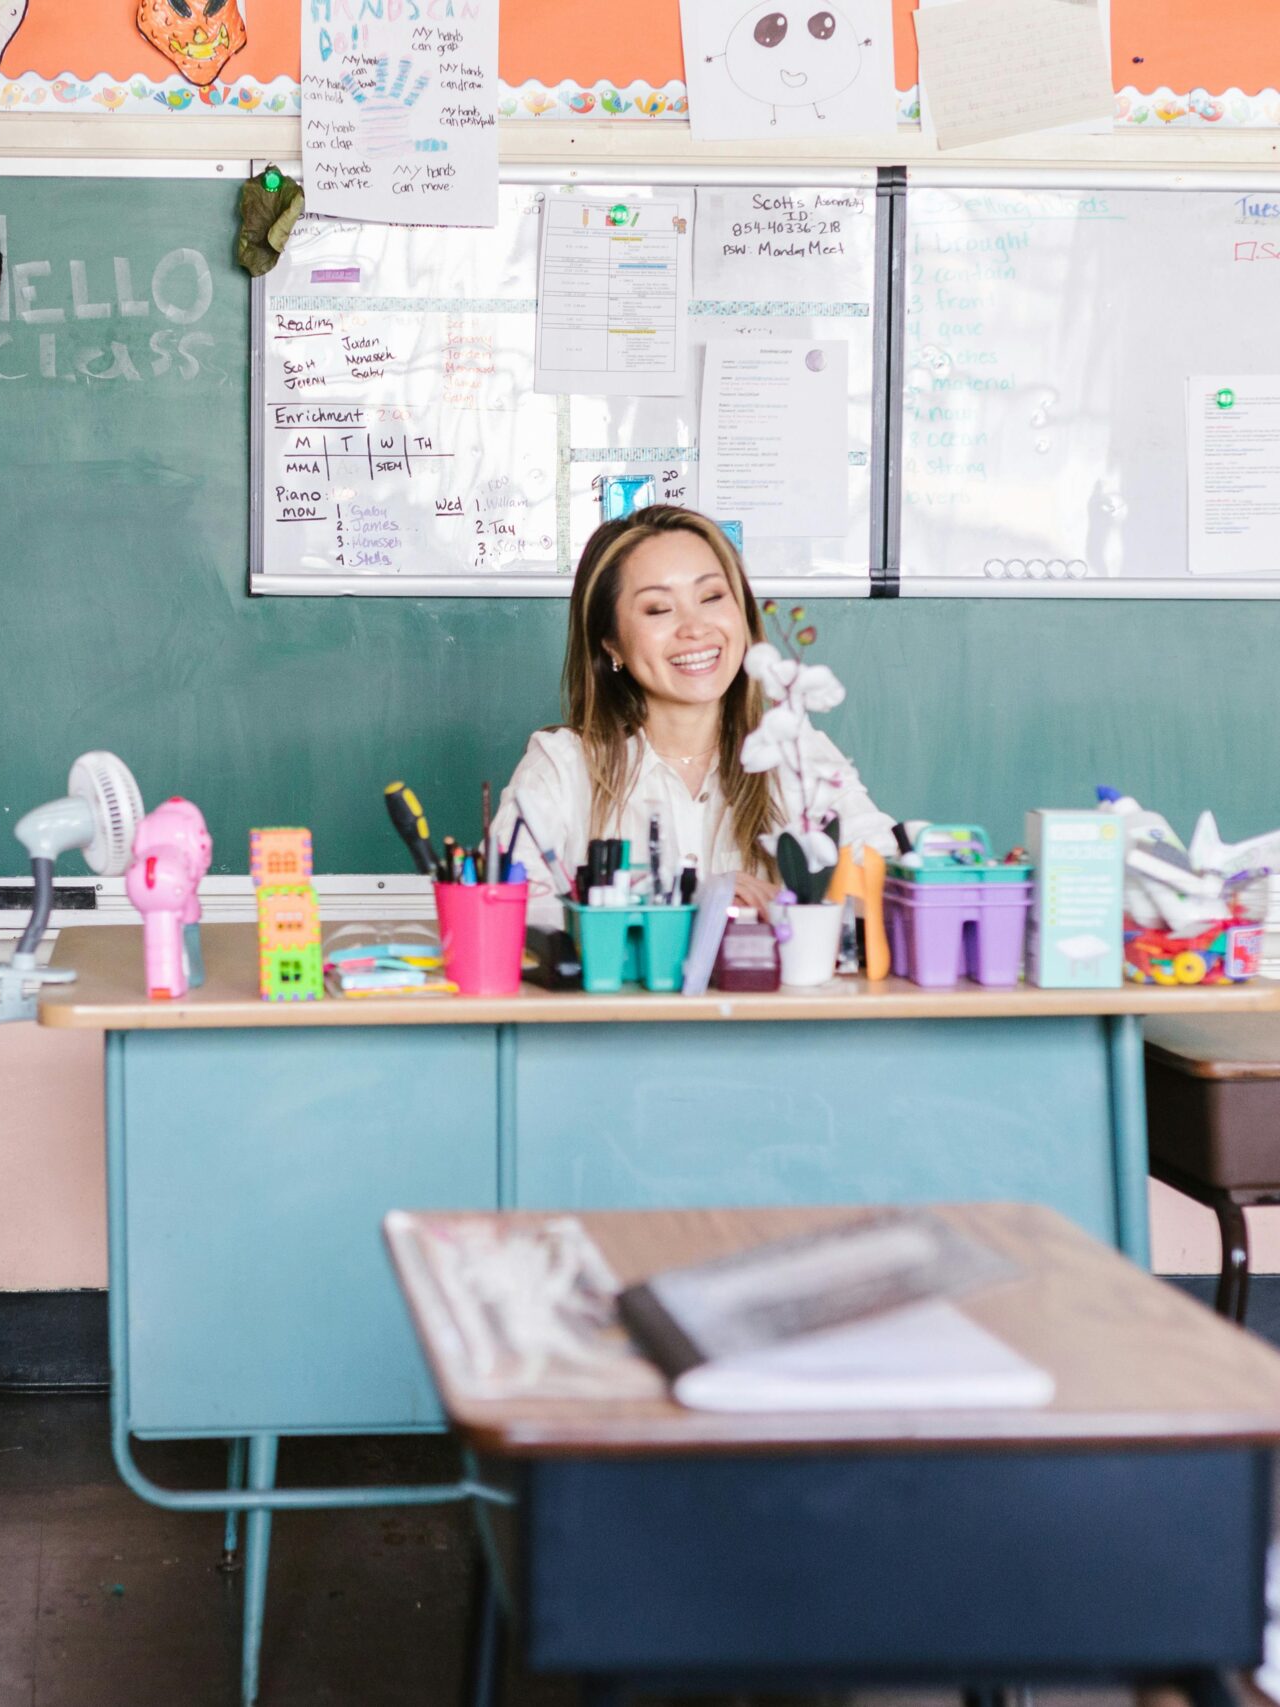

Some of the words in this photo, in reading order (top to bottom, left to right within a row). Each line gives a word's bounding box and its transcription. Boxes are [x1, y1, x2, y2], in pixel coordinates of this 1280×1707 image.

[412, 27, 433, 41] My
[412, 43, 432, 52] can
[440, 63, 458, 75] My
[303, 74, 325, 89] My
[440, 81, 458, 90] can
[304, 92, 323, 101] can
[441, 106, 457, 118] My
[307, 120, 330, 136] My
[439, 118, 459, 129] can
[306, 138, 326, 150] can
[315, 162, 338, 179] My
[339, 161, 372, 175] hands
[392, 165, 423, 181] My
[426, 163, 456, 179] hands
